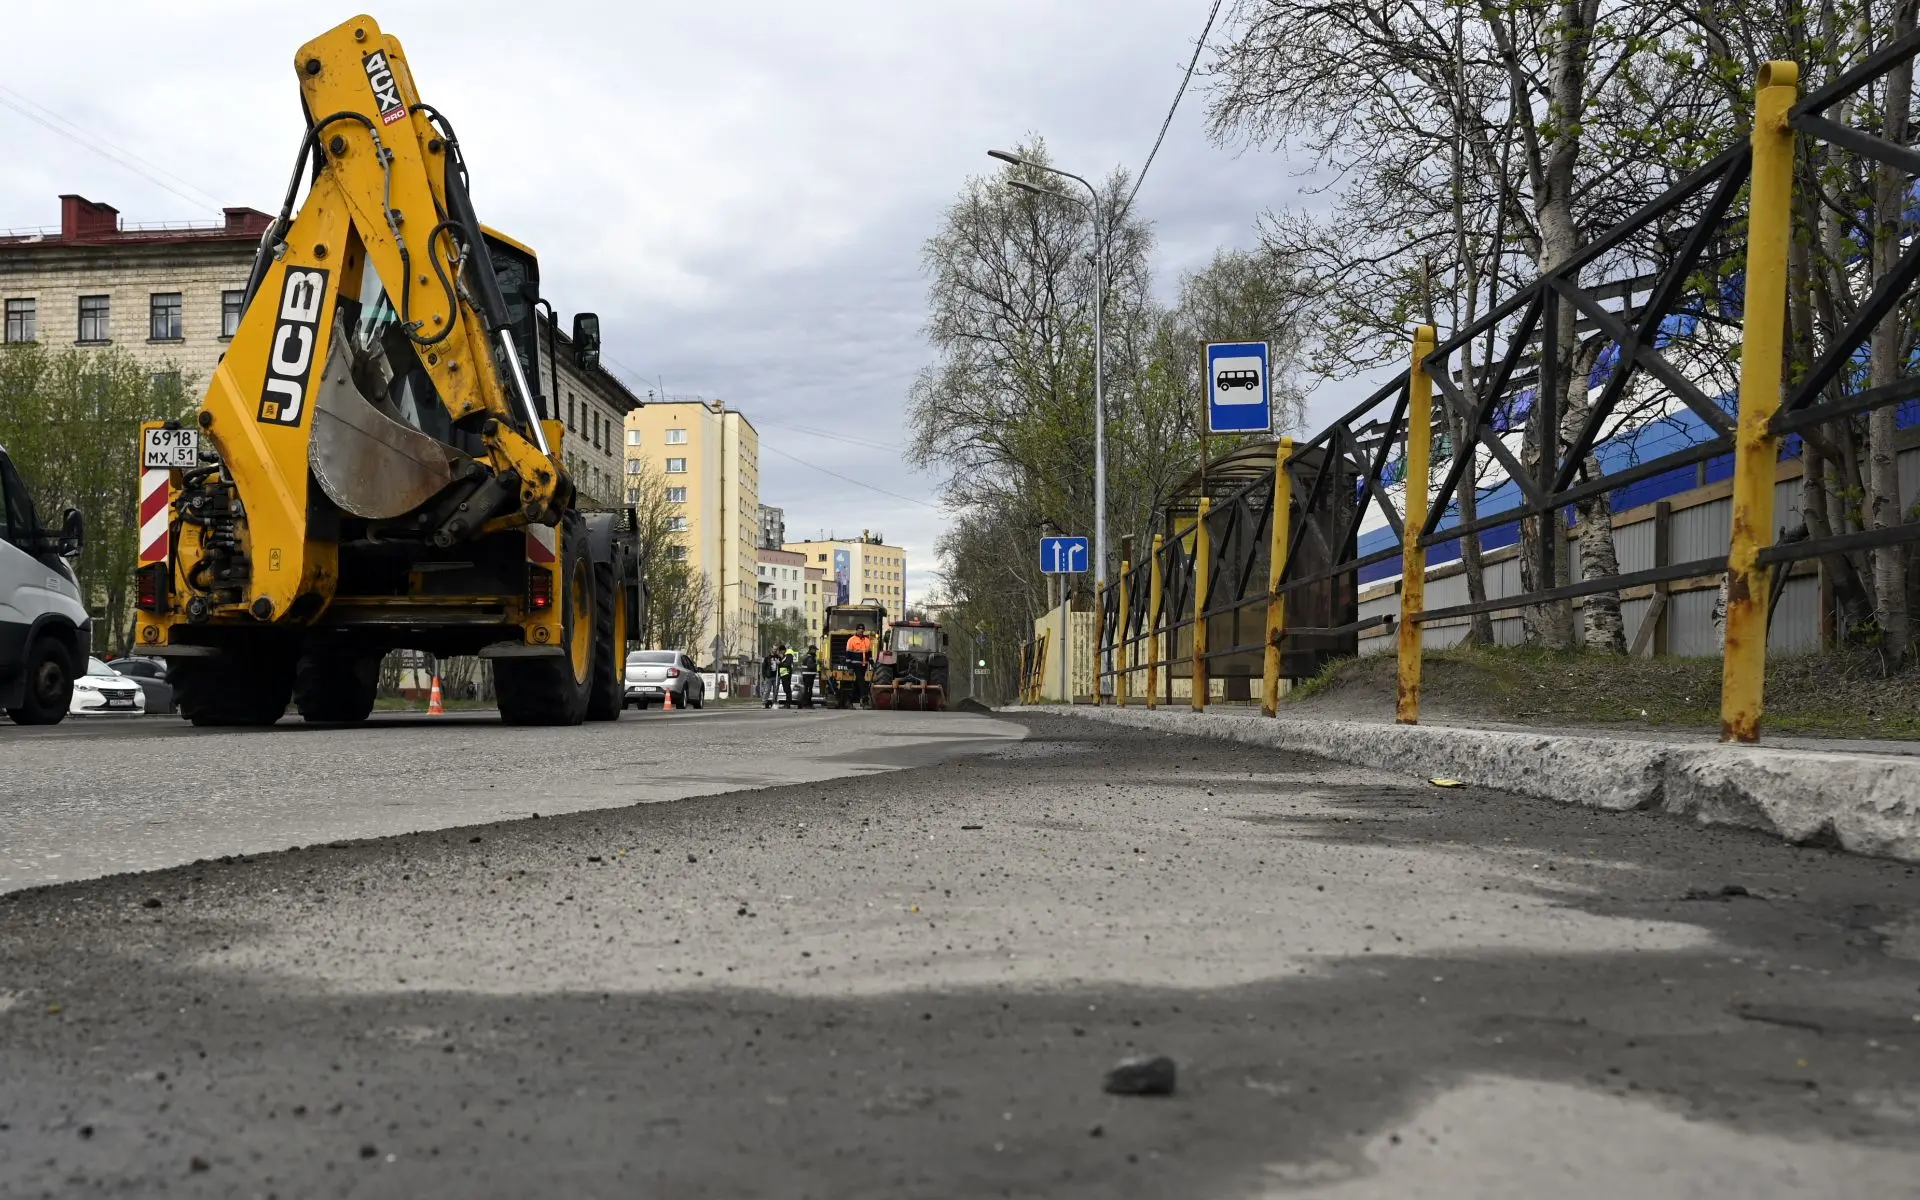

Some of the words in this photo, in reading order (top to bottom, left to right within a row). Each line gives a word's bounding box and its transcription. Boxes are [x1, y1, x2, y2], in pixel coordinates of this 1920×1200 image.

[366, 53, 400, 112] 40X
[384, 109, 405, 124] PRO
[266, 272, 323, 422] JCB
[152, 431, 191, 446] 6918
[178, 449, 193, 460] 51
